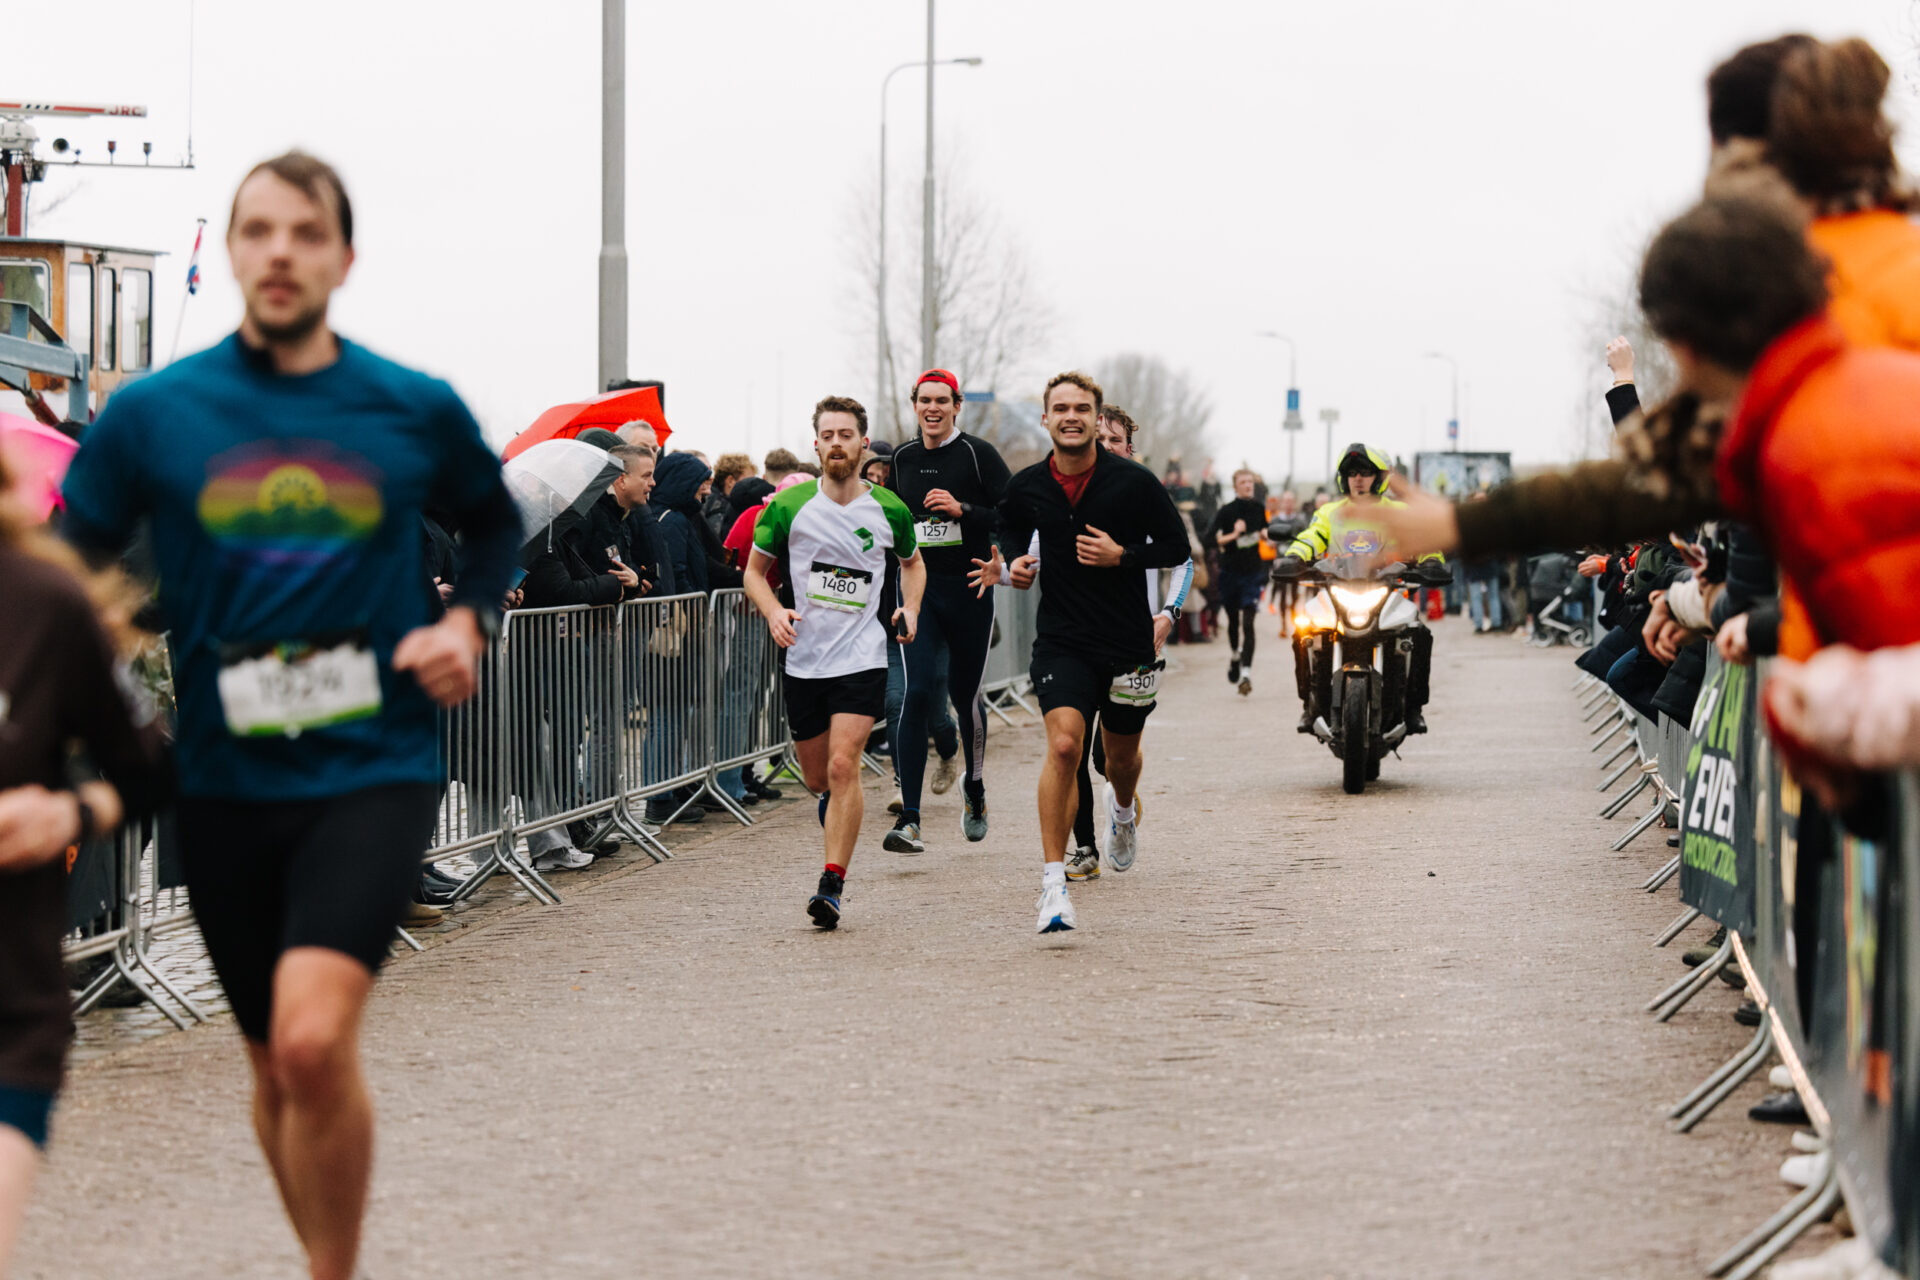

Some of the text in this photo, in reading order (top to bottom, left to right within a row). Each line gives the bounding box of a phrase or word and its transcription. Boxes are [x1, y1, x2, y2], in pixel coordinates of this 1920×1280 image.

[109, 105, 142, 117] JRC
[922, 525, 948, 537] 1257
[822, 576, 857, 595] 1480
[1128, 674, 1155, 690] 1901
